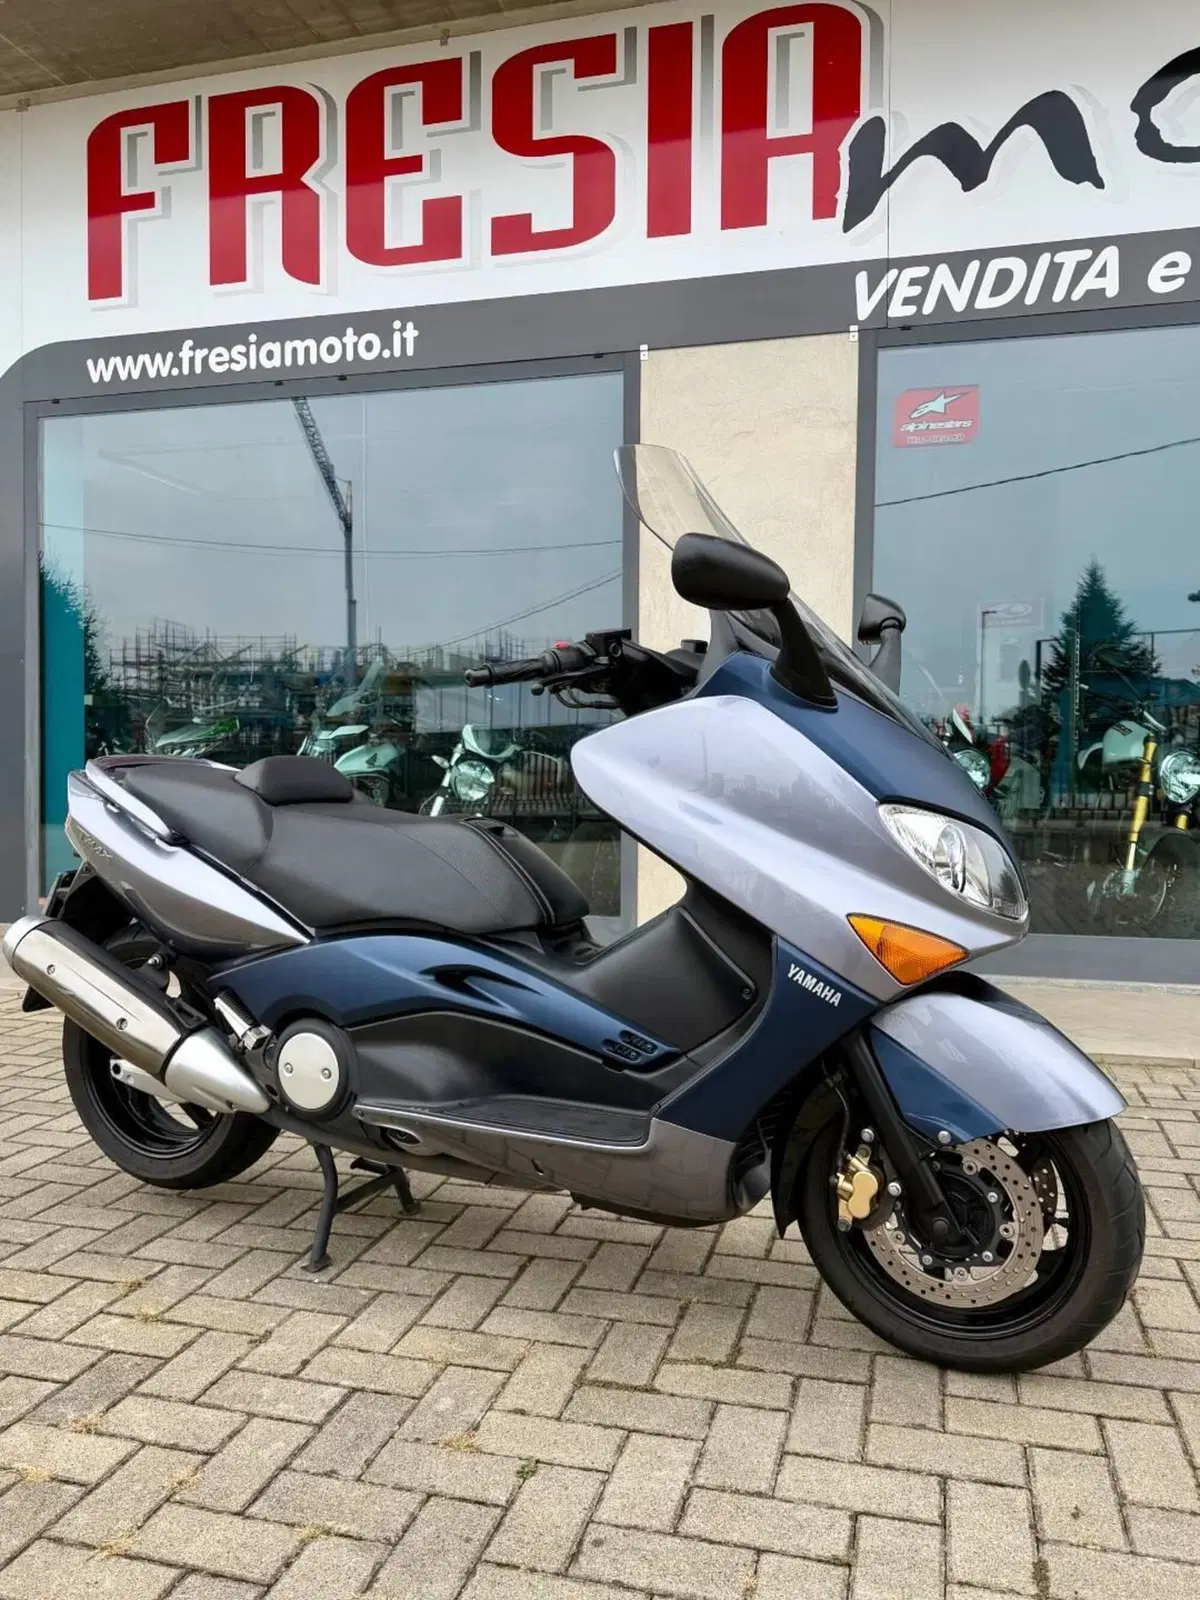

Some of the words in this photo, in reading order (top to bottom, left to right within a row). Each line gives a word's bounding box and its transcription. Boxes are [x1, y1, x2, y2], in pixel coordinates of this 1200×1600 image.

[87, 3, 863, 300] FRESIA
[855, 245, 1120, 321] VENDITA
[1147, 250, 1192, 294] e
[86, 320, 419, 384] www.fresiamoto.it
[787, 962, 842, 1007] YAMAHA
